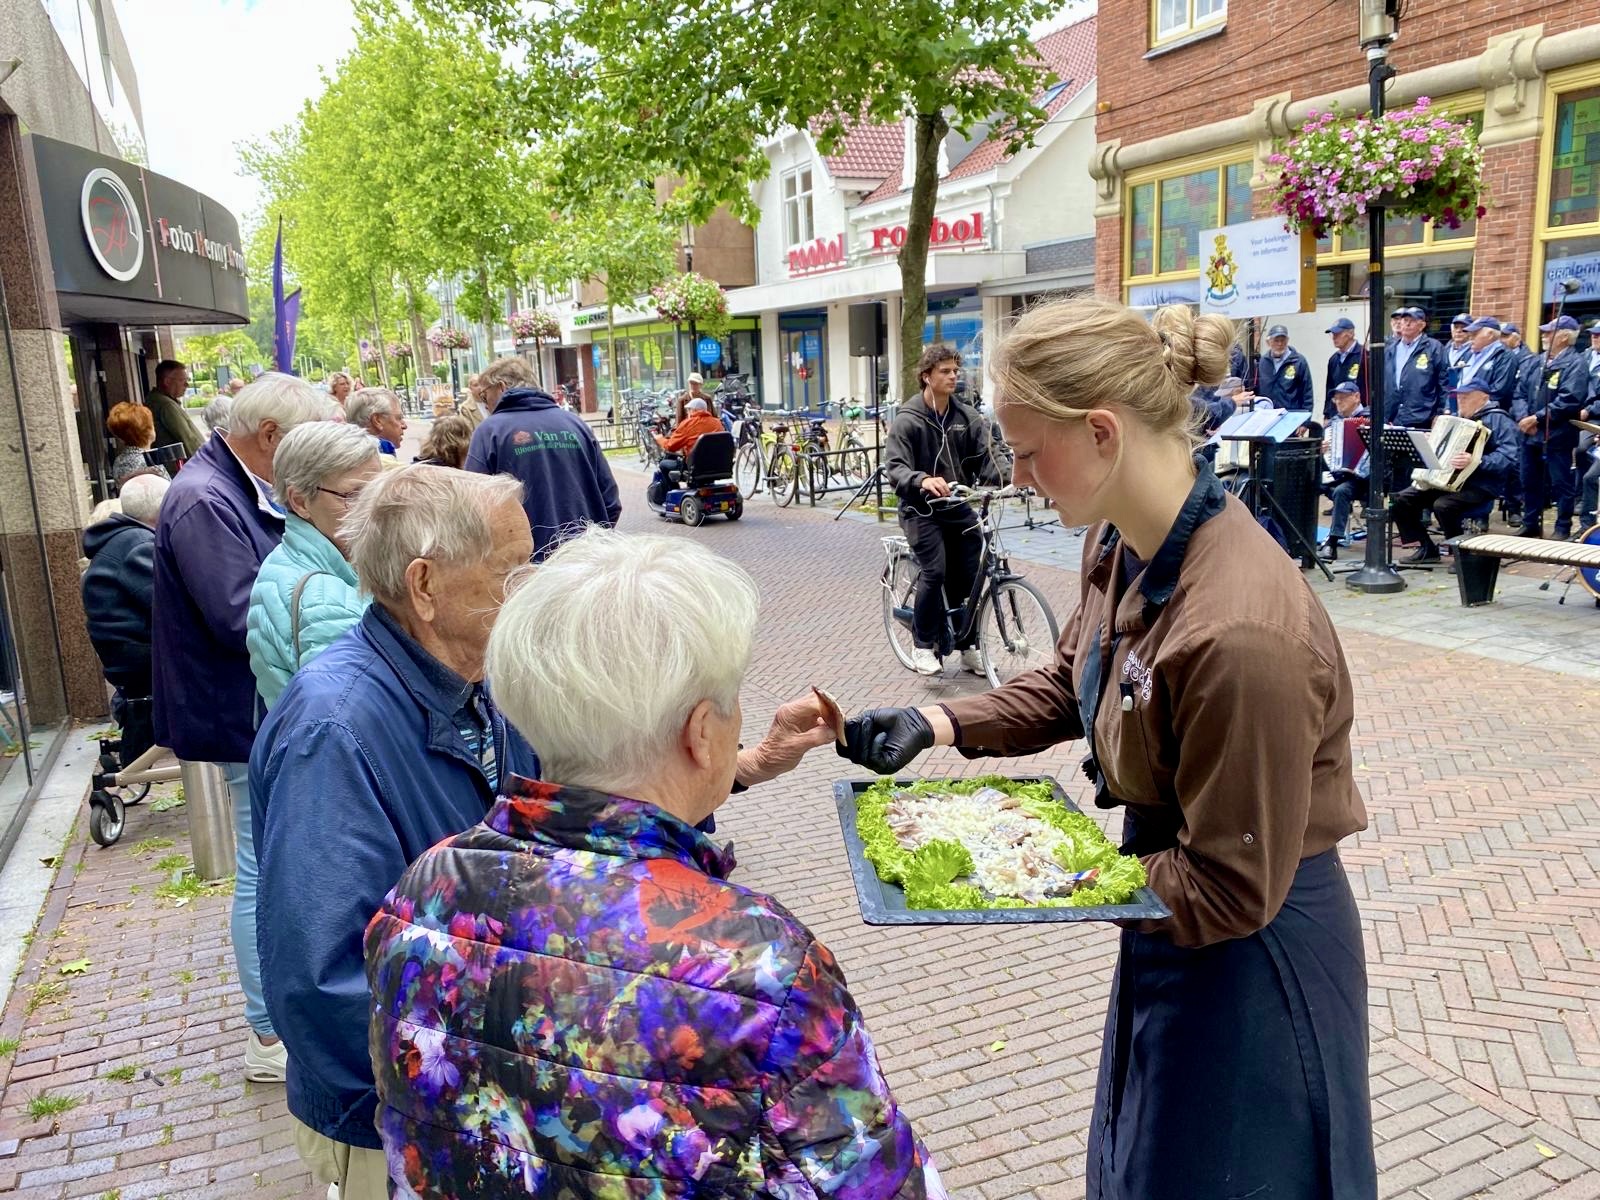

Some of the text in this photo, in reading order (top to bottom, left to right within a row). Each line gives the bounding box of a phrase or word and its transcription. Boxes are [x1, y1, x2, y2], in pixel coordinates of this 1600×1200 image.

[159, 217, 194, 254] Foto
[873, 212, 984, 249] robol
[788, 233, 845, 272] roobol
[535, 431, 558, 440] Van
